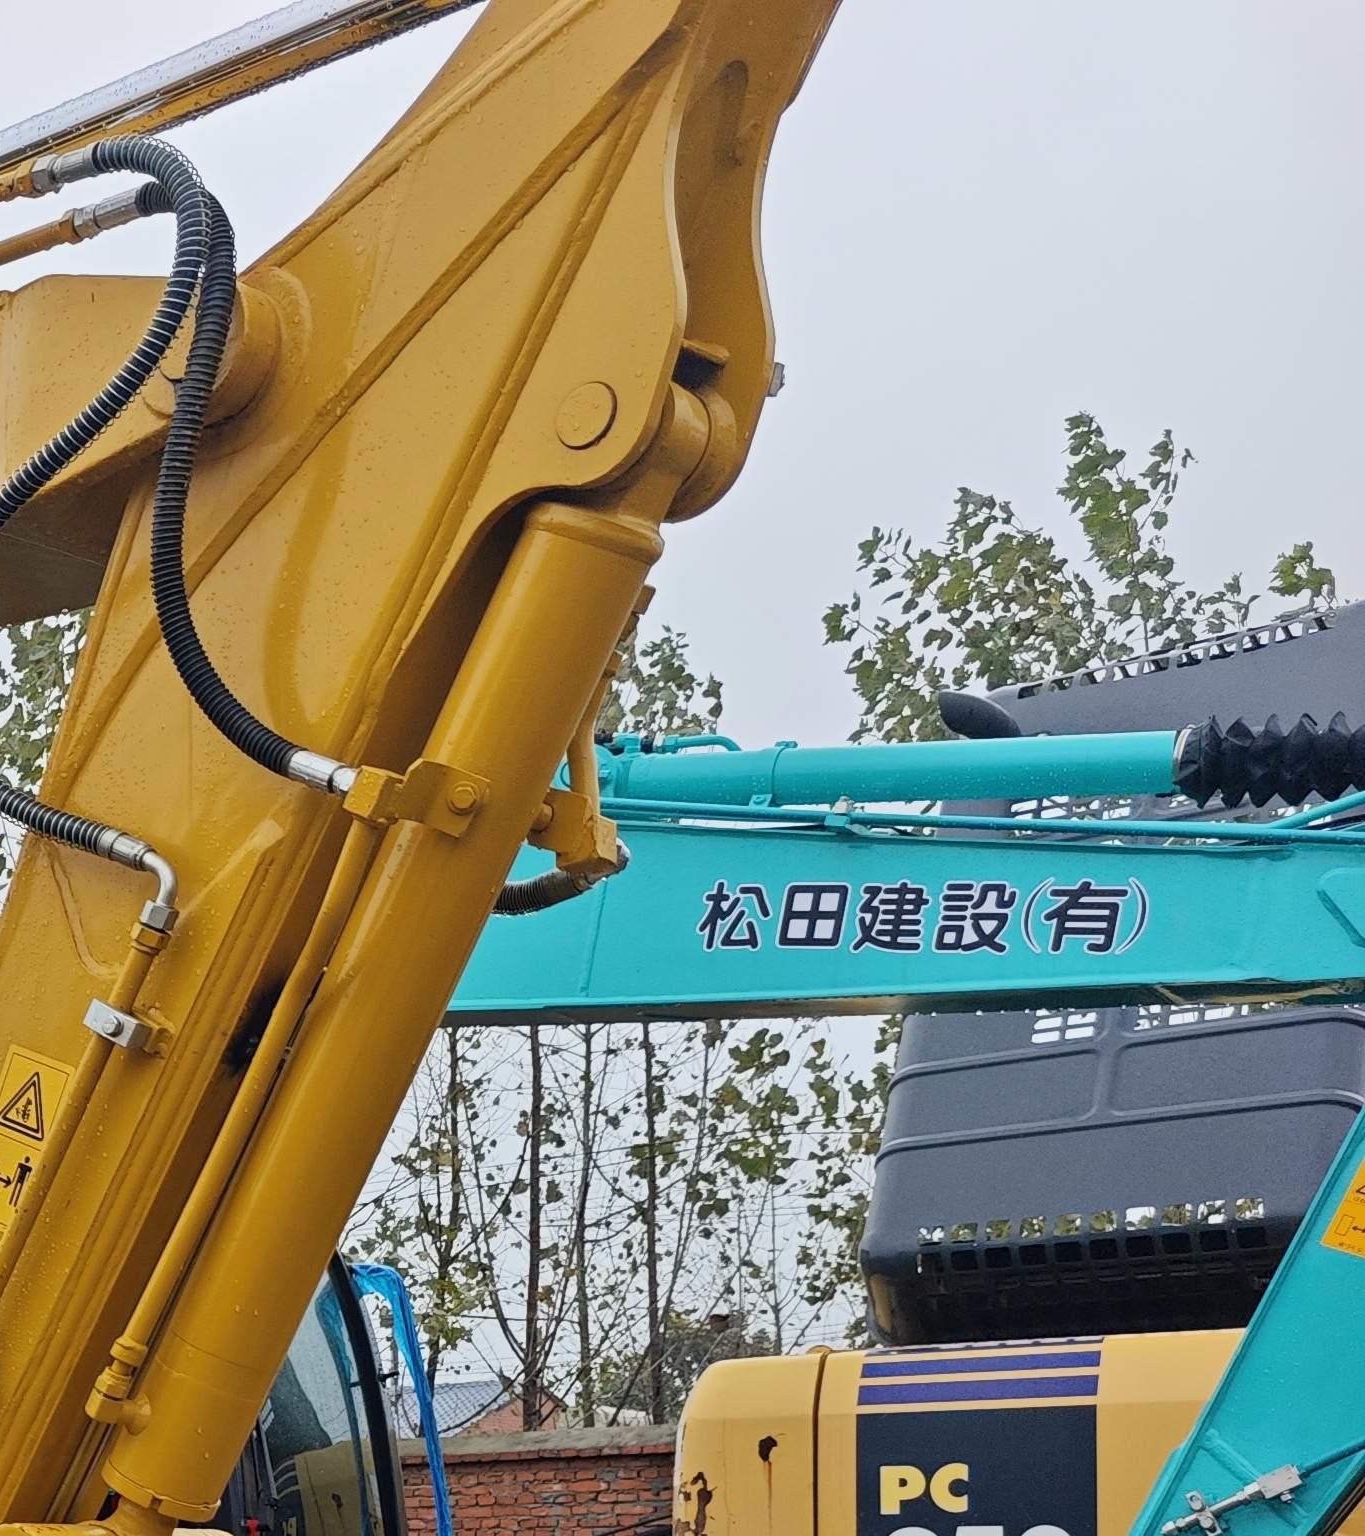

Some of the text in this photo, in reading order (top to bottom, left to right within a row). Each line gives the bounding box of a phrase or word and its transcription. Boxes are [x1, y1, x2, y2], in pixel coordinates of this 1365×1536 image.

[697, 878, 1149, 955] 松田建設(有)
[880, 1462, 969, 1515] PC
